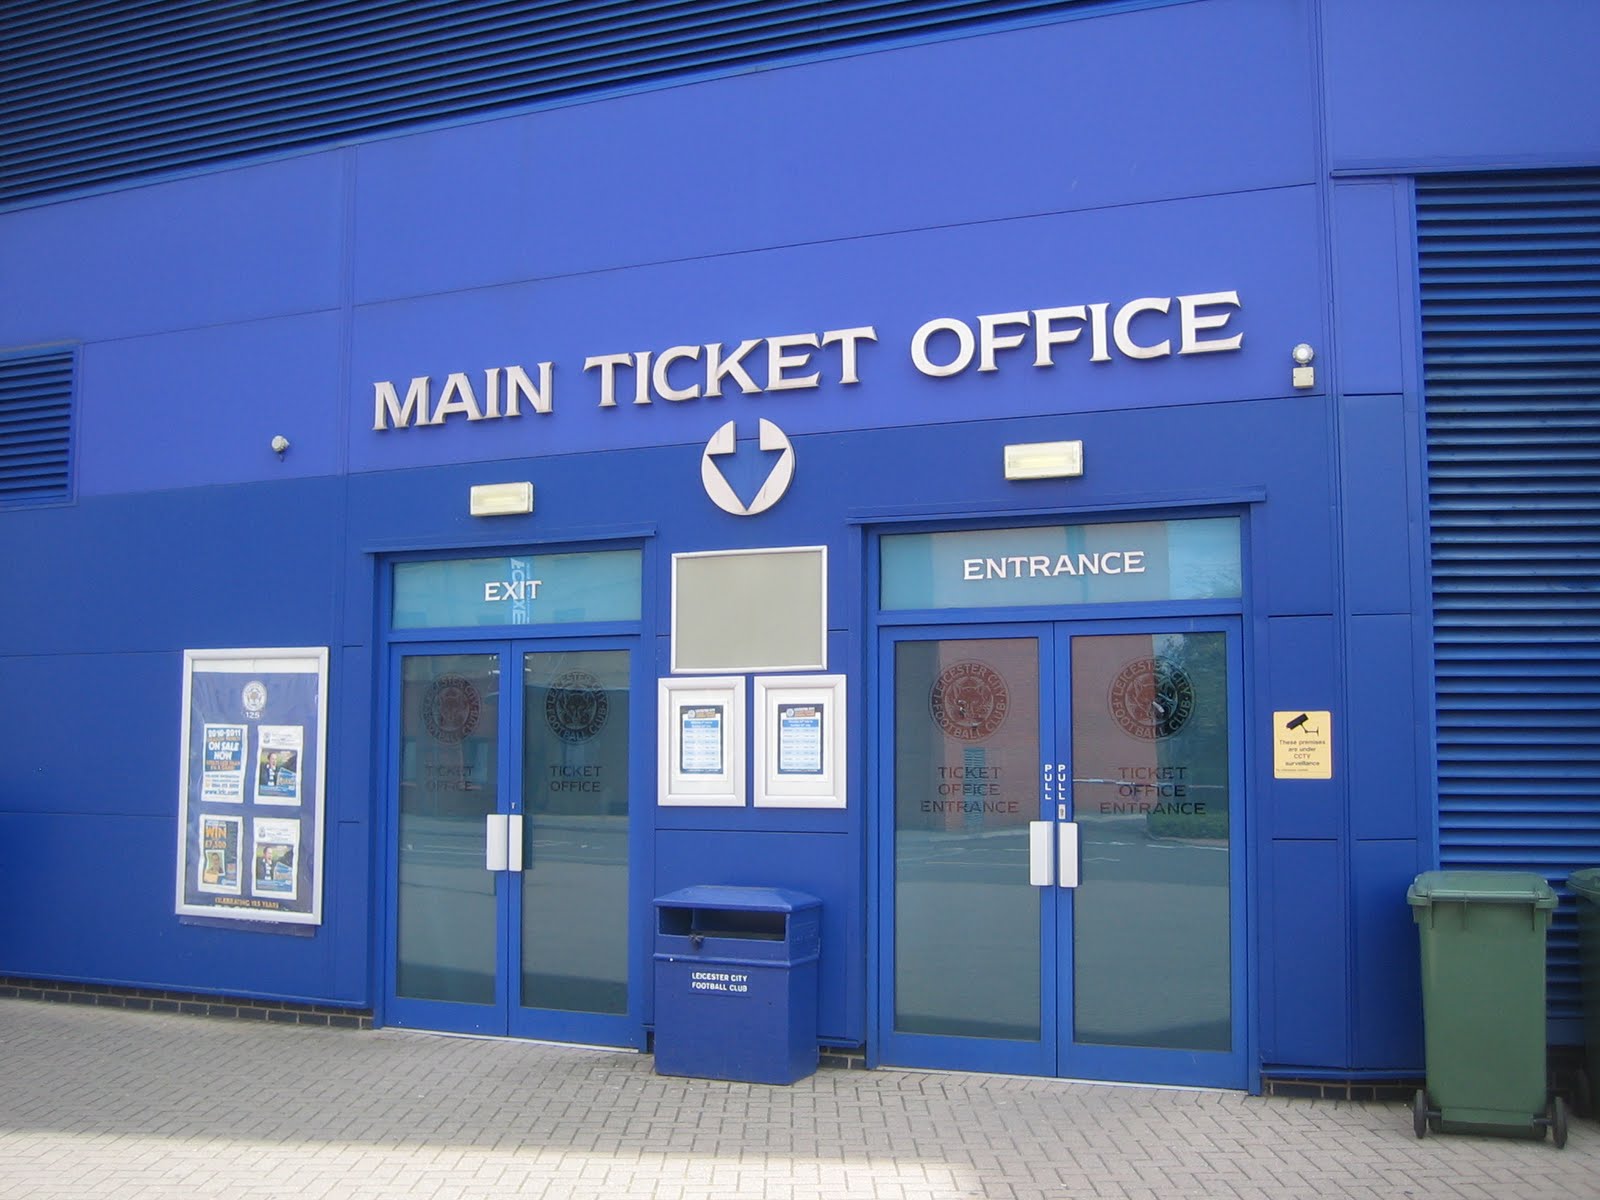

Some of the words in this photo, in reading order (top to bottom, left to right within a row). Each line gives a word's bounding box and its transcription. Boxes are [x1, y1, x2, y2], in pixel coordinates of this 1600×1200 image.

[372, 361, 554, 430] MAIN
[583, 325, 878, 407] TICKET
[910, 290, 1244, 377] OFFICE
[963, 551, 1146, 580] ENTRANCE
[484, 579, 543, 602] EXIT
[933, 663, 988, 698] LEICESTER
[987, 674, 1008, 698] CITY
[1171, 670, 1192, 695] CITY
[933, 703, 985, 739] FOOTBALL
[985, 702, 1006, 732] CLUB
[1112, 701, 1168, 739] FOOTBALL
[1168, 700, 1192, 731] CLUB
[208, 741, 220, 751] ON
[221, 741, 239, 752] SALE
[214, 751, 232, 760] NOW
[549, 765, 603, 777] TICKET
[937, 766, 1002, 779] TICKET
[1117, 766, 1187, 780] TICKET
[550, 780, 601, 792] OFFICE
[1044, 763, 1053, 800] PULL
[1057, 763, 1066, 800] PULL
[937, 783, 1001, 796] OFFICE
[1118, 784, 1187, 798] OFFICE
[920, 800, 1020, 814] ENTRANCE
[1100, 802, 1207, 816] ENTRANCE
[205, 825, 227, 839] WIN
[692, 972, 729, 981] LEICESTER
[692, 981, 727, 990] FOOTBALL
[729, 984, 748, 992] CLUB
